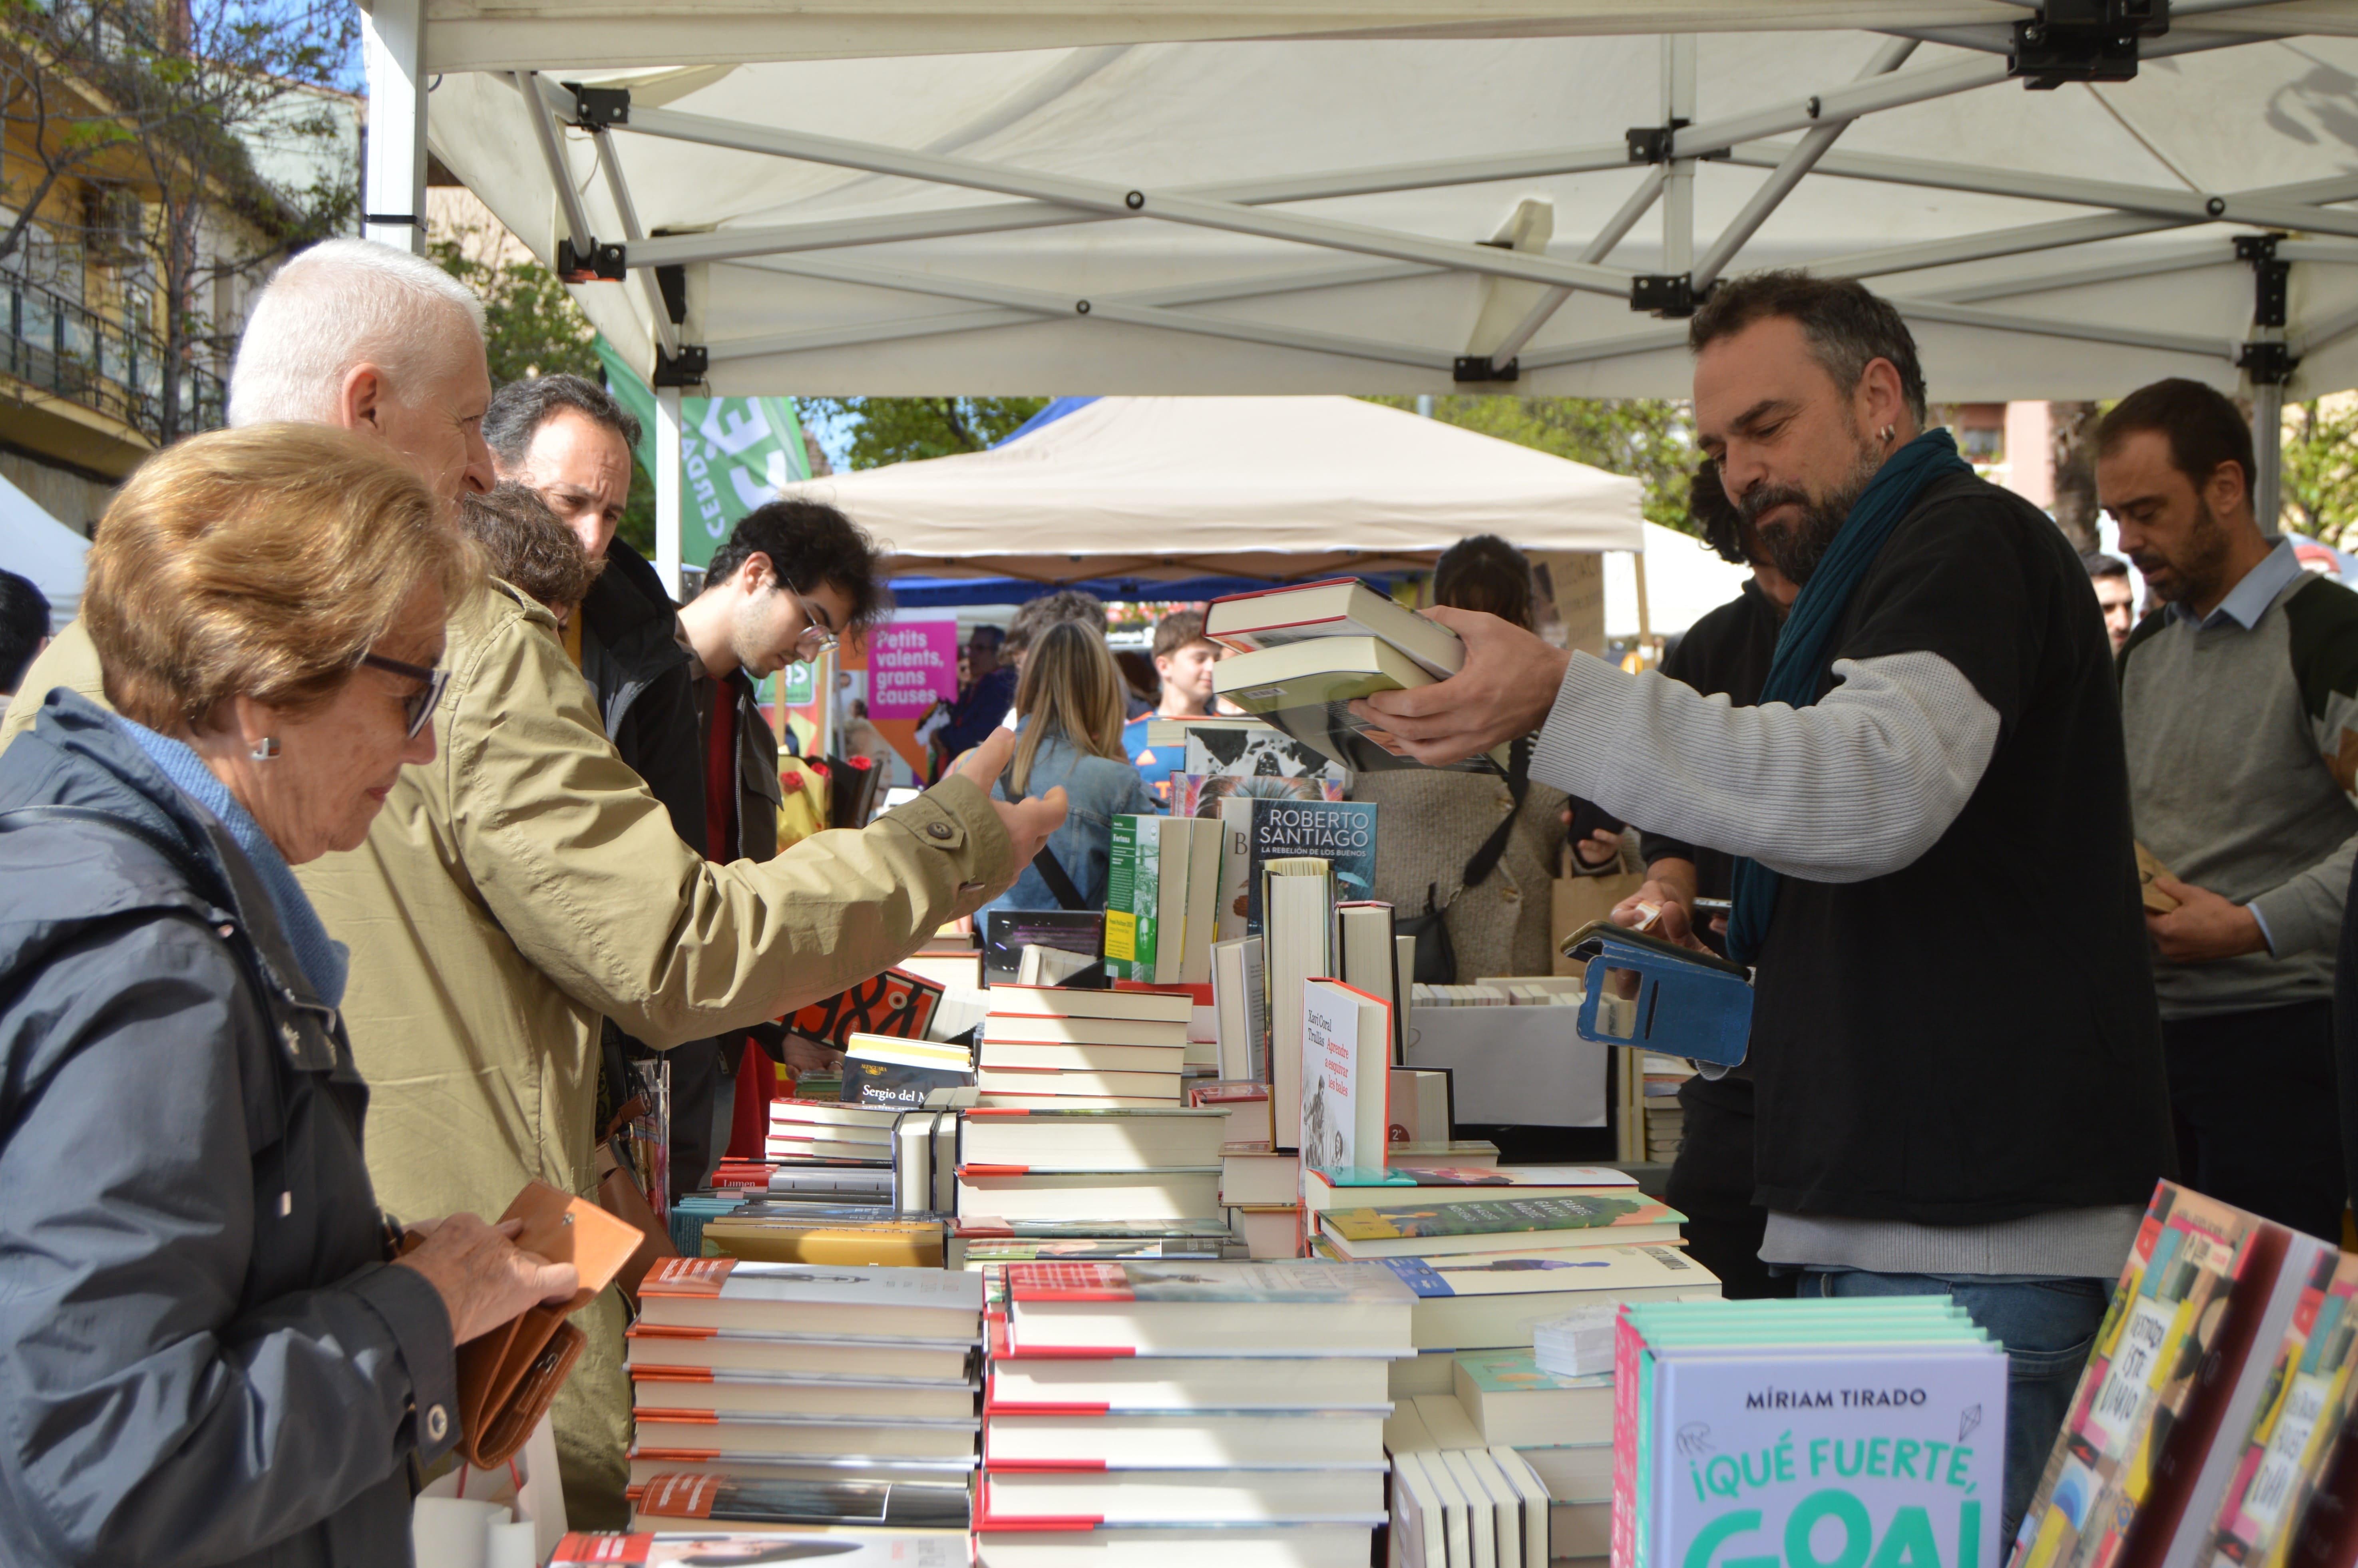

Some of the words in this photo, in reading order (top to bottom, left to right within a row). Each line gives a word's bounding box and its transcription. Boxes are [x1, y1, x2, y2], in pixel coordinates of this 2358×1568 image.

[876, 629, 927, 649] Petits
[876, 649, 944, 668] valents,
[876, 670, 926, 690] grans
[876, 689, 937, 704] causes
[1270, 809, 1369, 829] ROBERTO
[1259, 826, 1369, 847] SANTIAGO
[1272, 846, 1308, 855] REBELIÓN
[1308, 1009, 1319, 1026] Xavi
[1319, 1015, 1331, 1032] Coral
[1308, 1027, 1324, 1047] Trullàs
[1326, 1037, 1349, 1060] Aprendre
[860, 1063, 887, 1073] ALFAGUARA
[1325, 1059, 1328, 1068] a
[1328, 1061, 1349, 1078] esquivar
[863, 1084, 895, 1101] Sergio
[898, 1089, 915, 1102] del
[1335, 1078, 1348, 1097] bales
[723, 1179, 756, 1188] Lumen
[1746, 1386, 1833, 1409] MÍRIAM
[1841, 1388, 1927, 1408] TIRADO
[1809, 1437, 1978, 1495] FUERTE,
